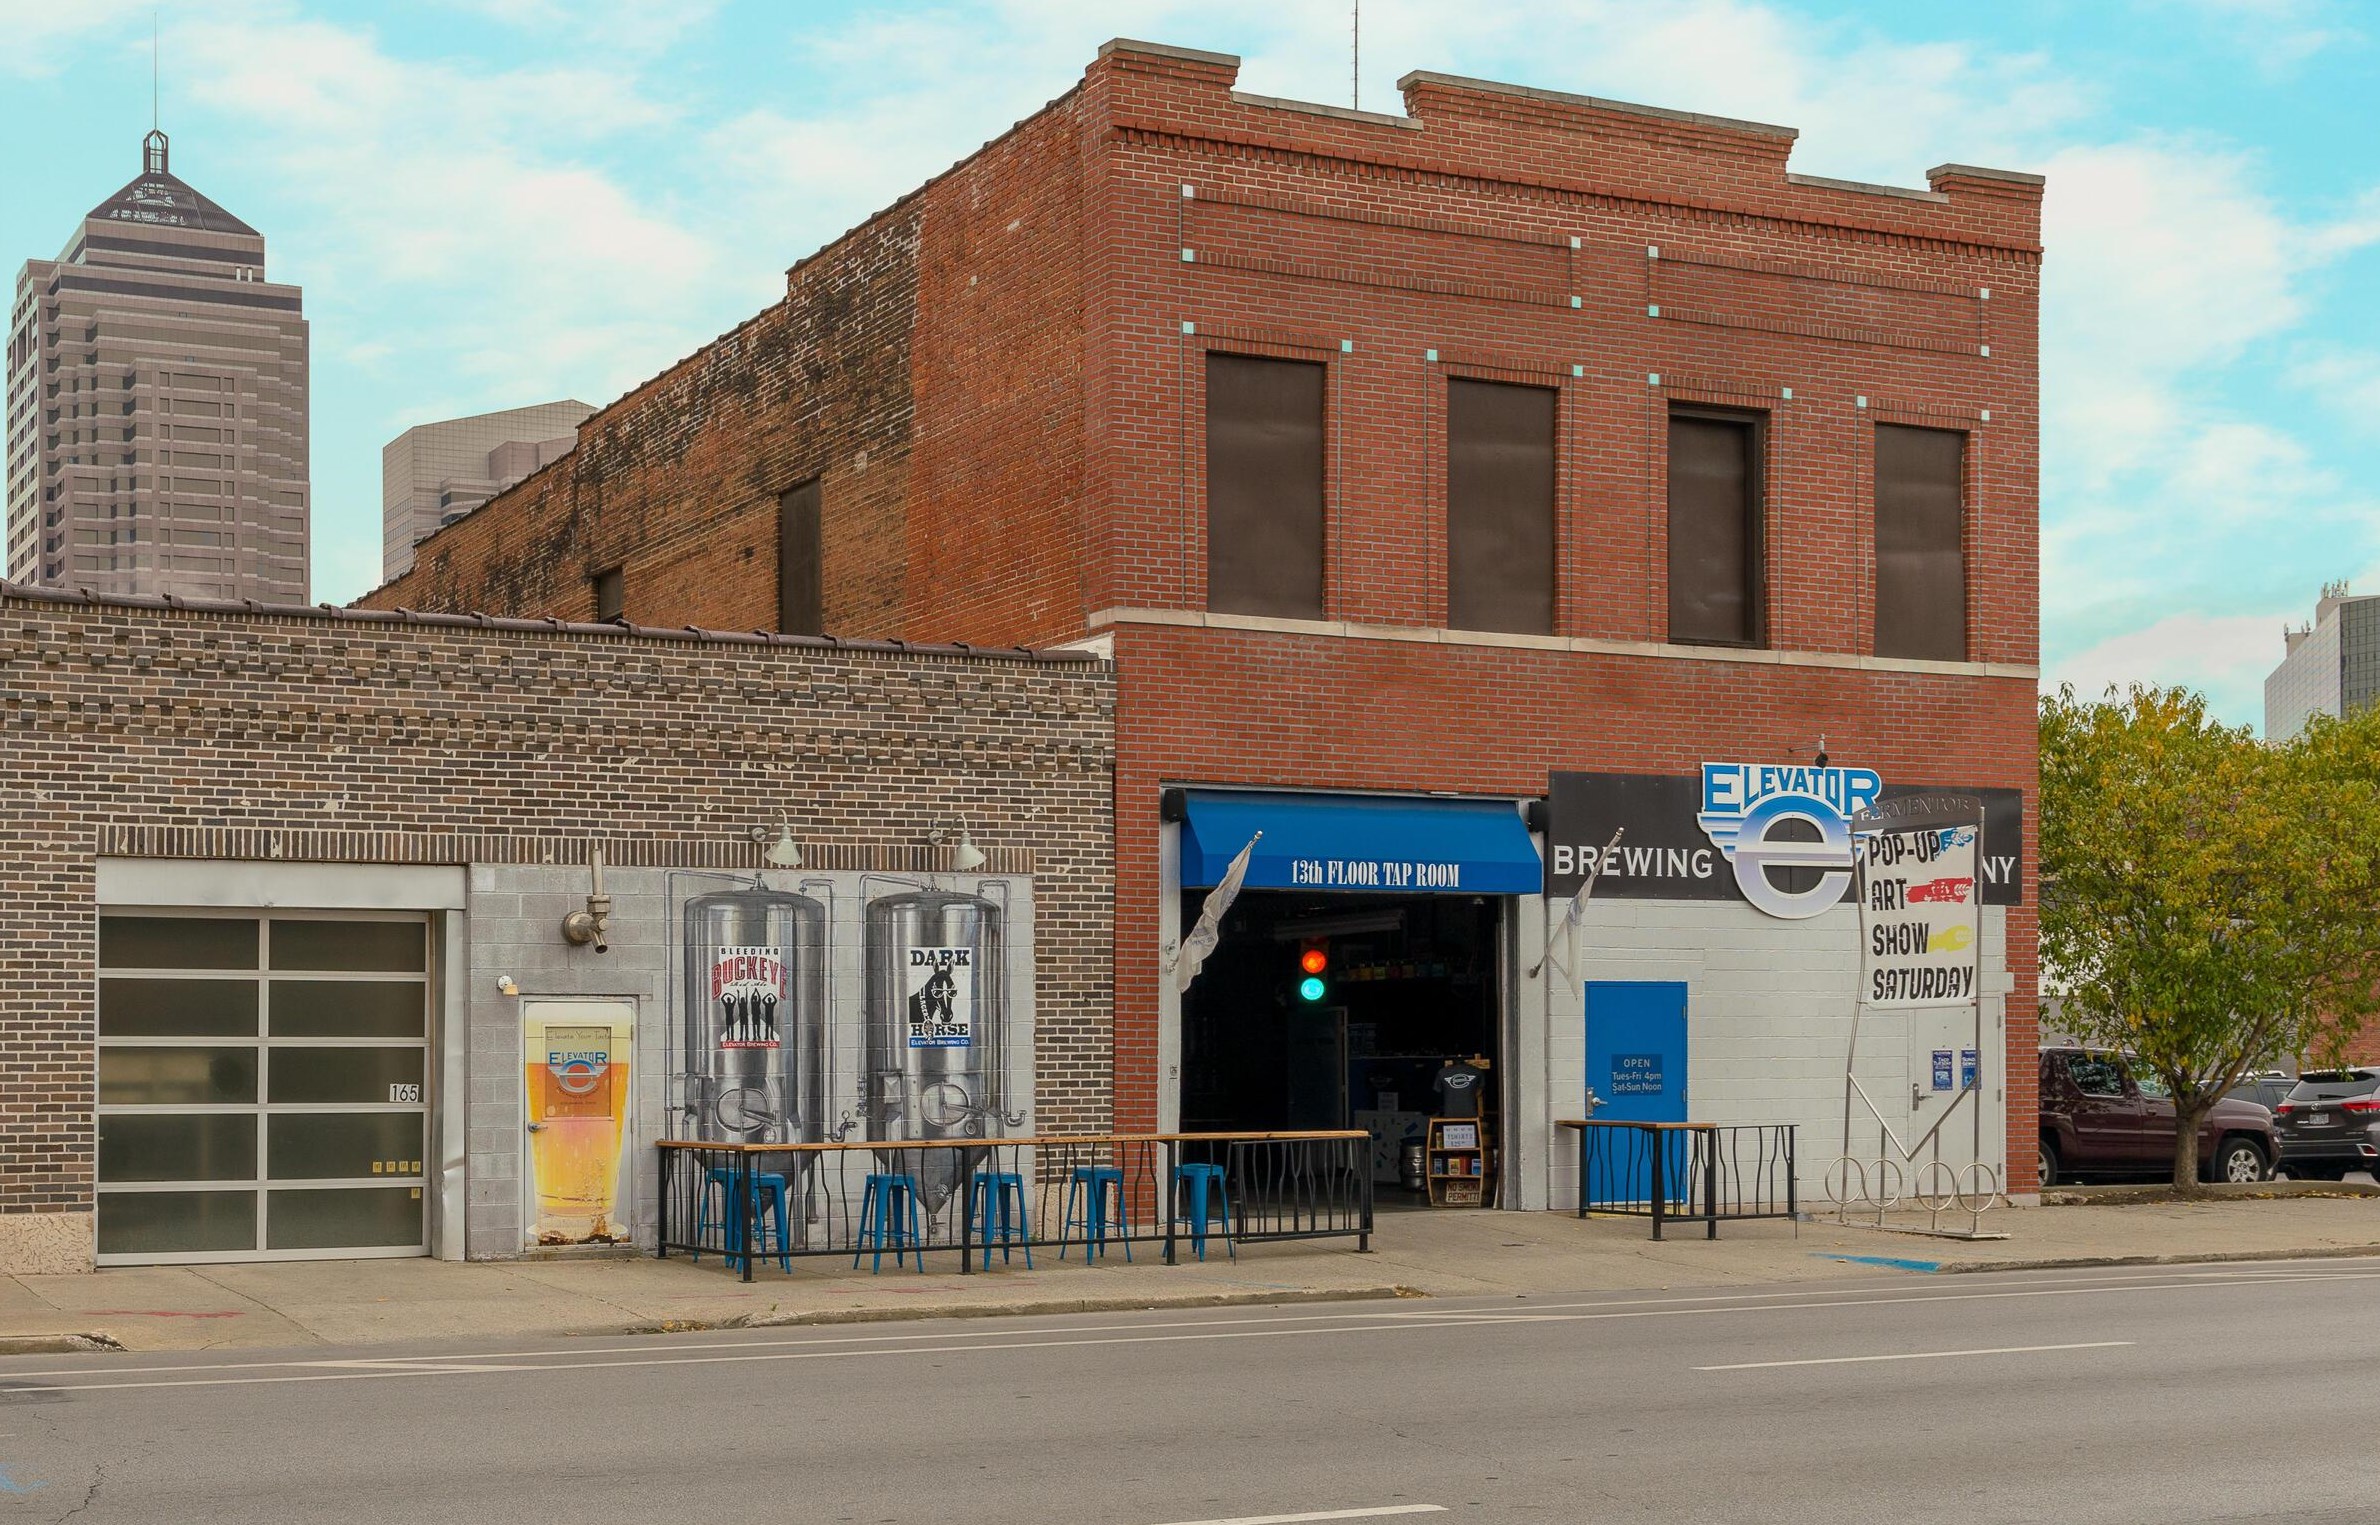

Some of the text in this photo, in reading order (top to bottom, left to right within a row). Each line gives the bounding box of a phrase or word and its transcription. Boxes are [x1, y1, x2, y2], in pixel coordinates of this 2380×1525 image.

[1704, 765, 1881, 815] ELEVATOR
[1554, 845, 1713, 878] BREWING
[1869, 831, 1940, 867] POP-UP
[1292, 860, 1460, 888] 13th FLOOR TAP ROOM
[1872, 878, 1907, 911] ART
[721, 947, 779, 955] BLEEDING
[1872, 922, 1930, 957] SHOW
[910, 949, 970, 967] DARK
[712, 955, 788, 1001] BUCKEYE
[1873, 966, 1974, 1001] SATURDAY
[549, 1051, 608, 1065] ELEVATOR
[1623, 1058, 1651, 1068] OPEN
[1612, 1071, 1662, 1082] Tues-Fri 4pm
[1612, 1082, 1662, 1091] Sat-Sun Noon
[391, 1084, 418, 1102] 165
